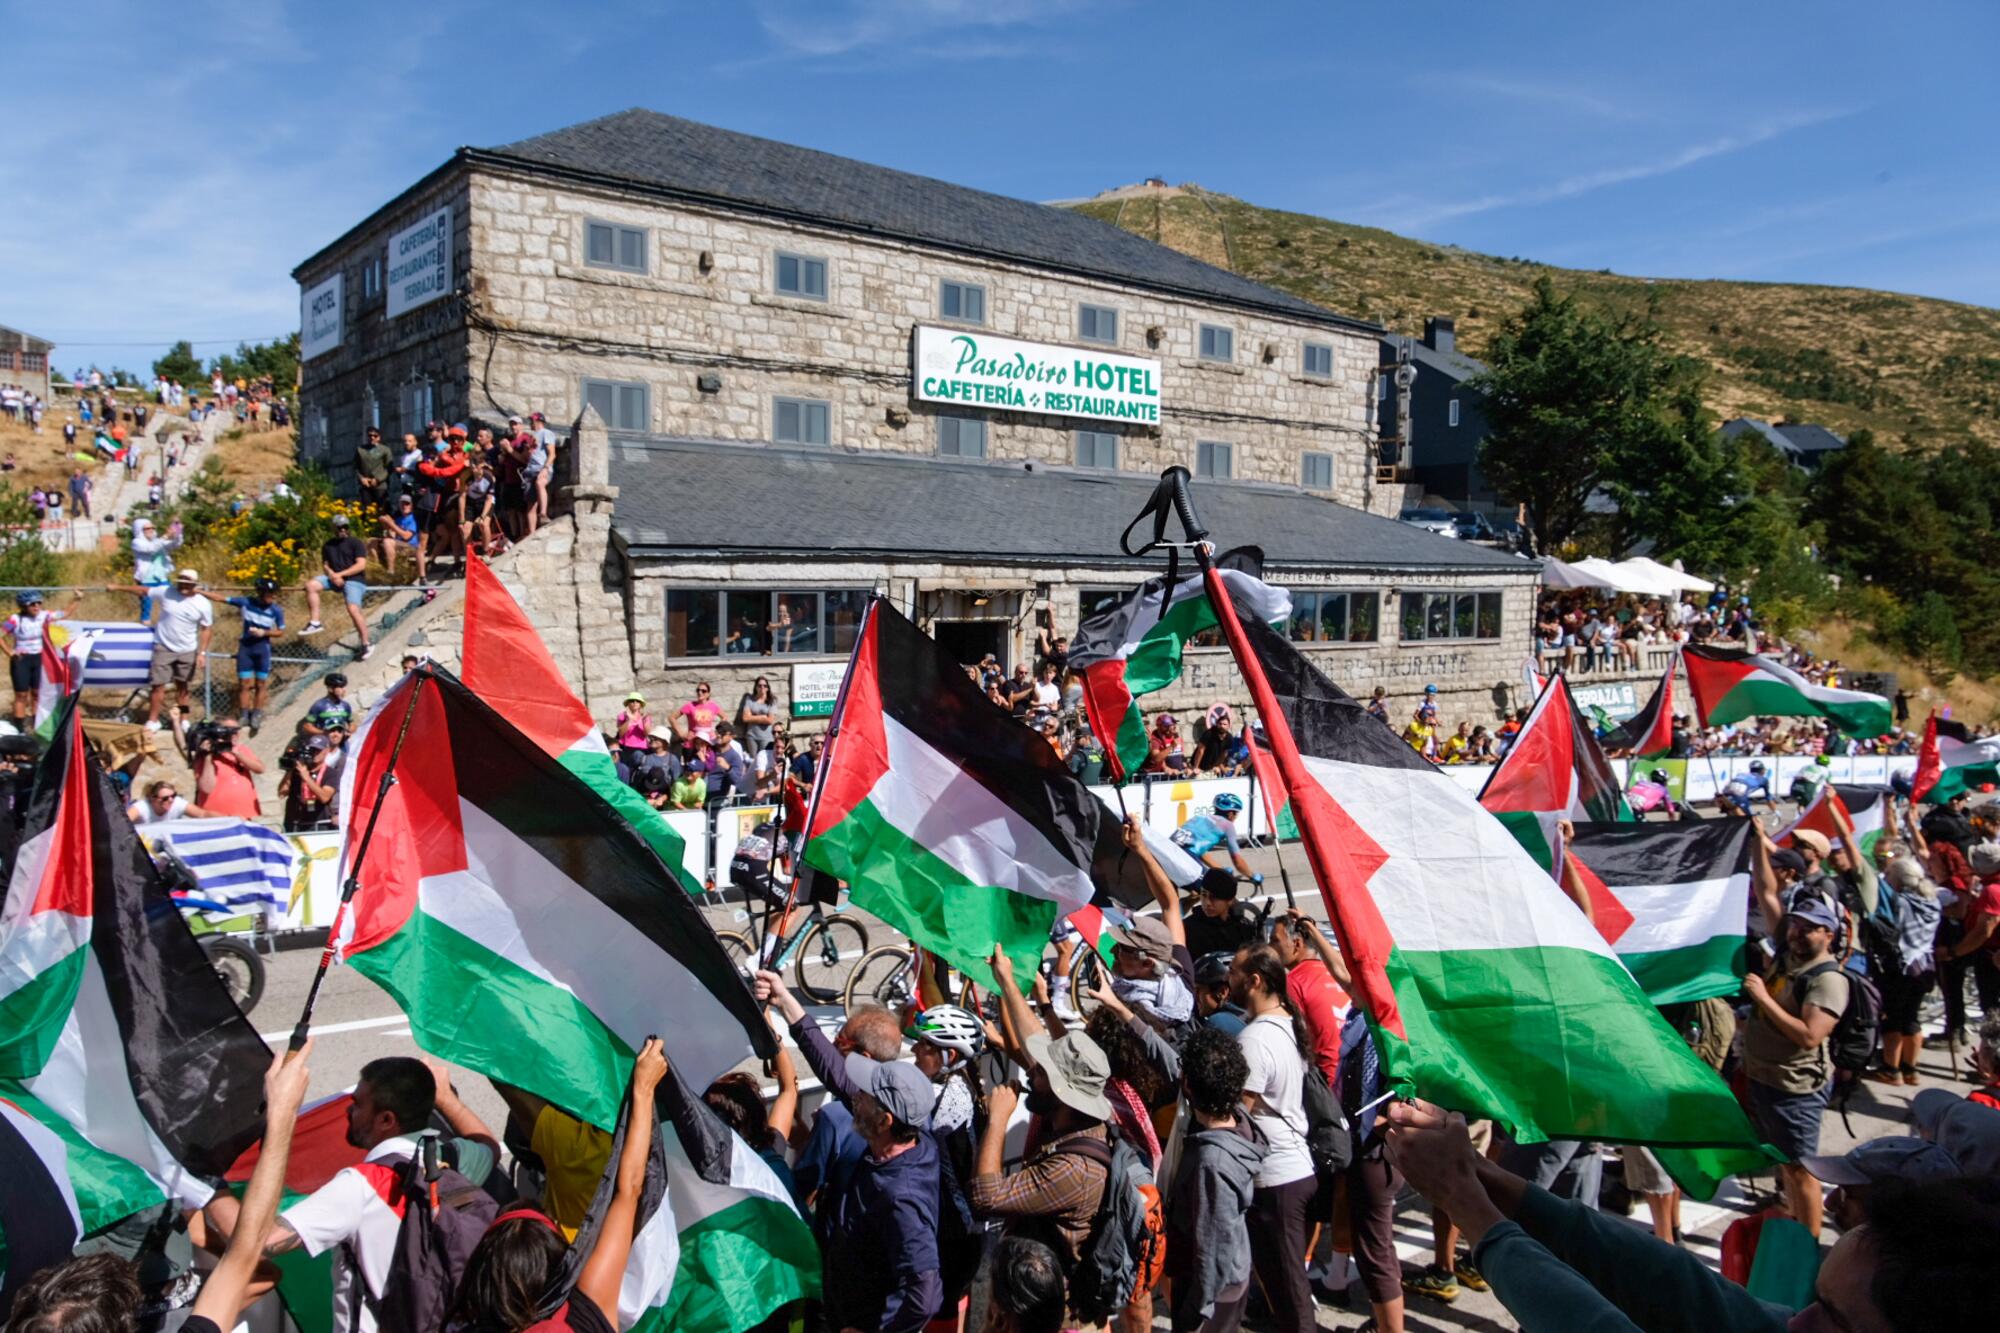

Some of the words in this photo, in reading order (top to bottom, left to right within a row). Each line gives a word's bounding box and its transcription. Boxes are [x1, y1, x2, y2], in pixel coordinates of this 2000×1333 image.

[390, 248, 437, 286] RESTAURANTE
[312, 289, 336, 317] HOTEL
[404, 273, 436, 304] TERRAZA
[951, 335, 1067, 385] Pasadoiro
[1074, 360, 1158, 396] HOTEL
[923, 377, 1026, 407] CAFETERÍA
[1045, 392, 1158, 421] RESTAURANTE
